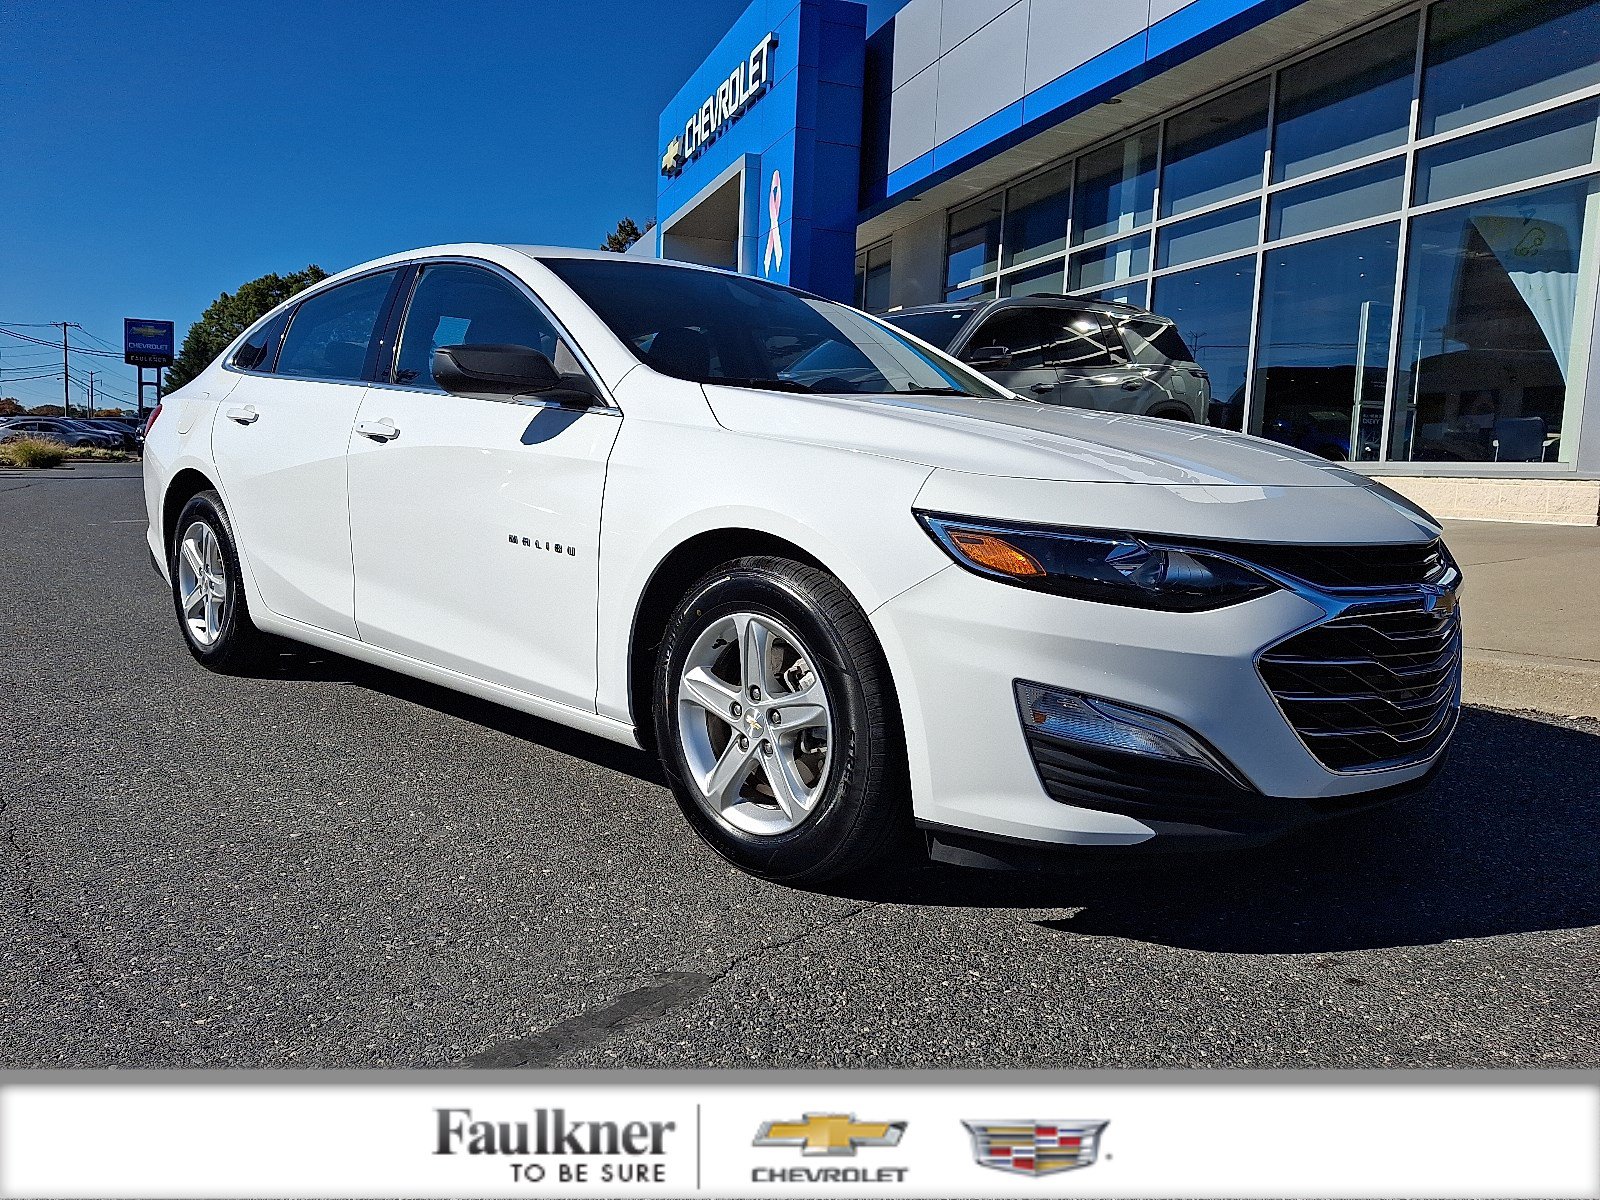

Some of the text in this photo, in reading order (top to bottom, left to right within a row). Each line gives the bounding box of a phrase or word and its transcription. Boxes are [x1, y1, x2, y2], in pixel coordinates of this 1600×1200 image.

[684, 30, 775, 159] CHEVROLET
[128, 342, 168, 351] CHEVROLET
[130, 355, 167, 363] FAULKNER
[508, 534, 576, 557] MALIBU
